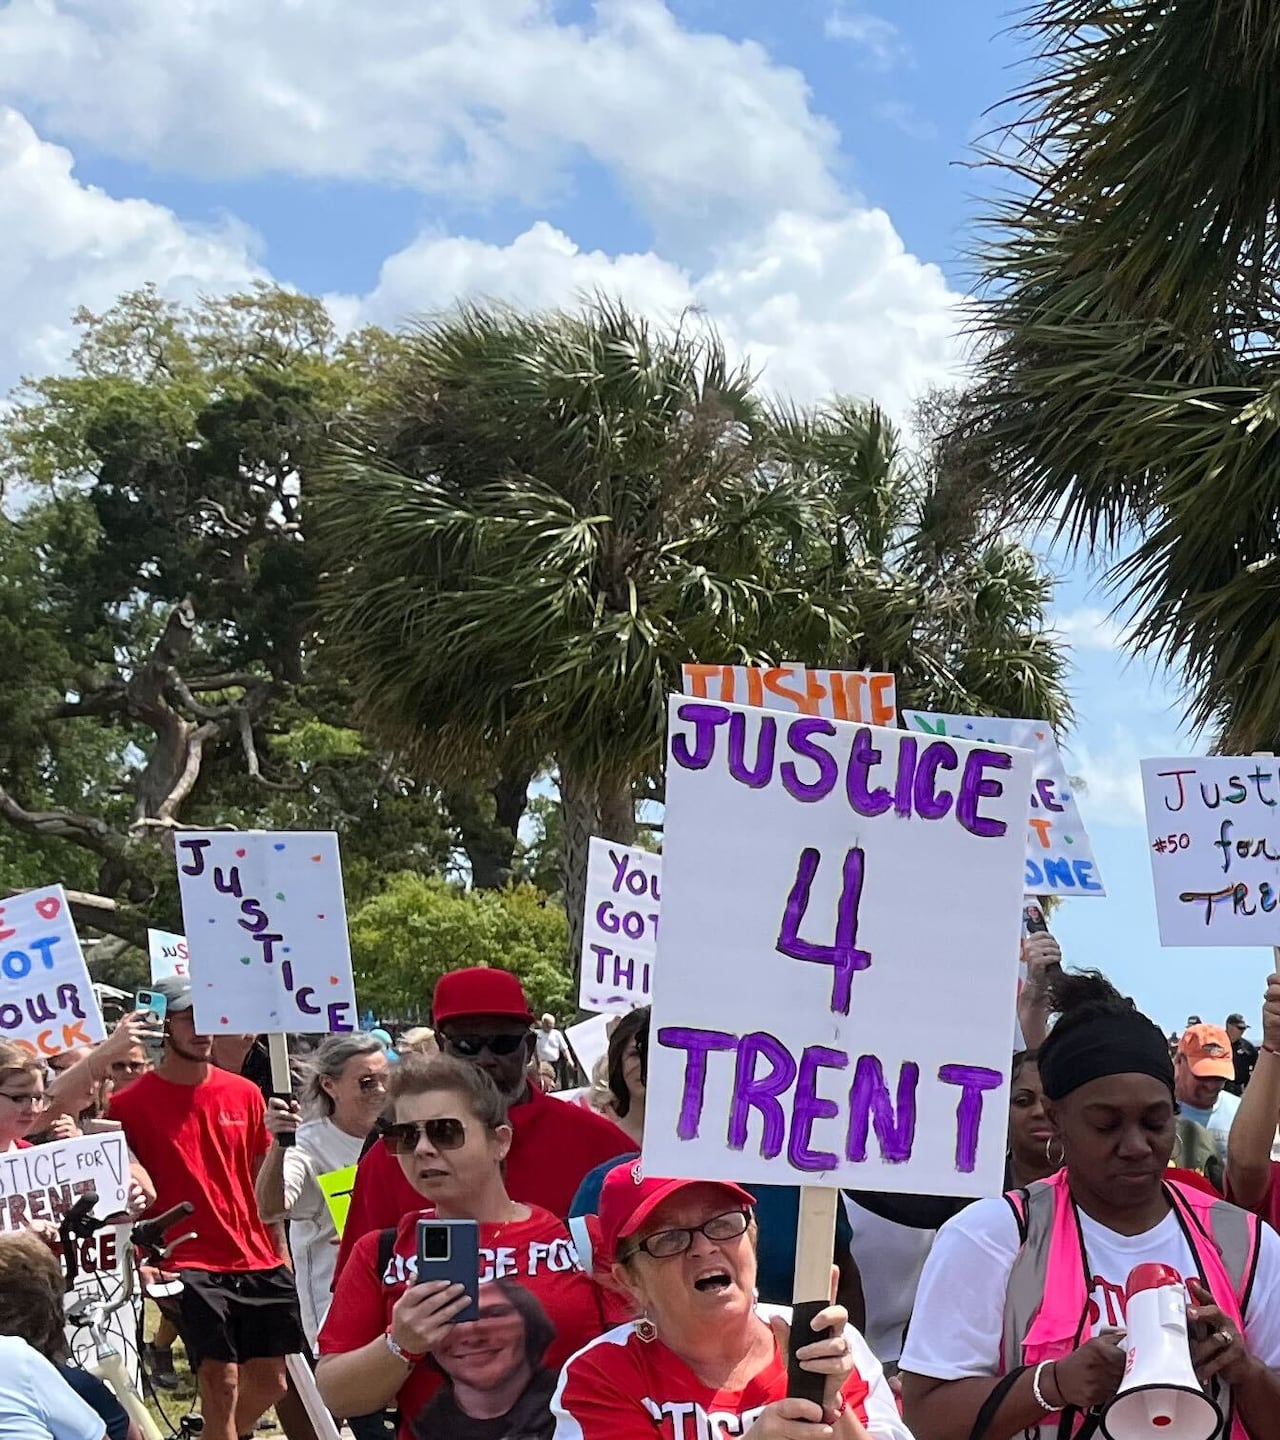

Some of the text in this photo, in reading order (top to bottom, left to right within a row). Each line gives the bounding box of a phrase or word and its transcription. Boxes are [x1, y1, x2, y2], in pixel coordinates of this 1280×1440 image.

[1152, 833, 1190, 855] #50
[775, 847, 872, 1016] 4
[657, 1026, 1003, 1174] TRENT
[0, 1149, 70, 1194] TICE
